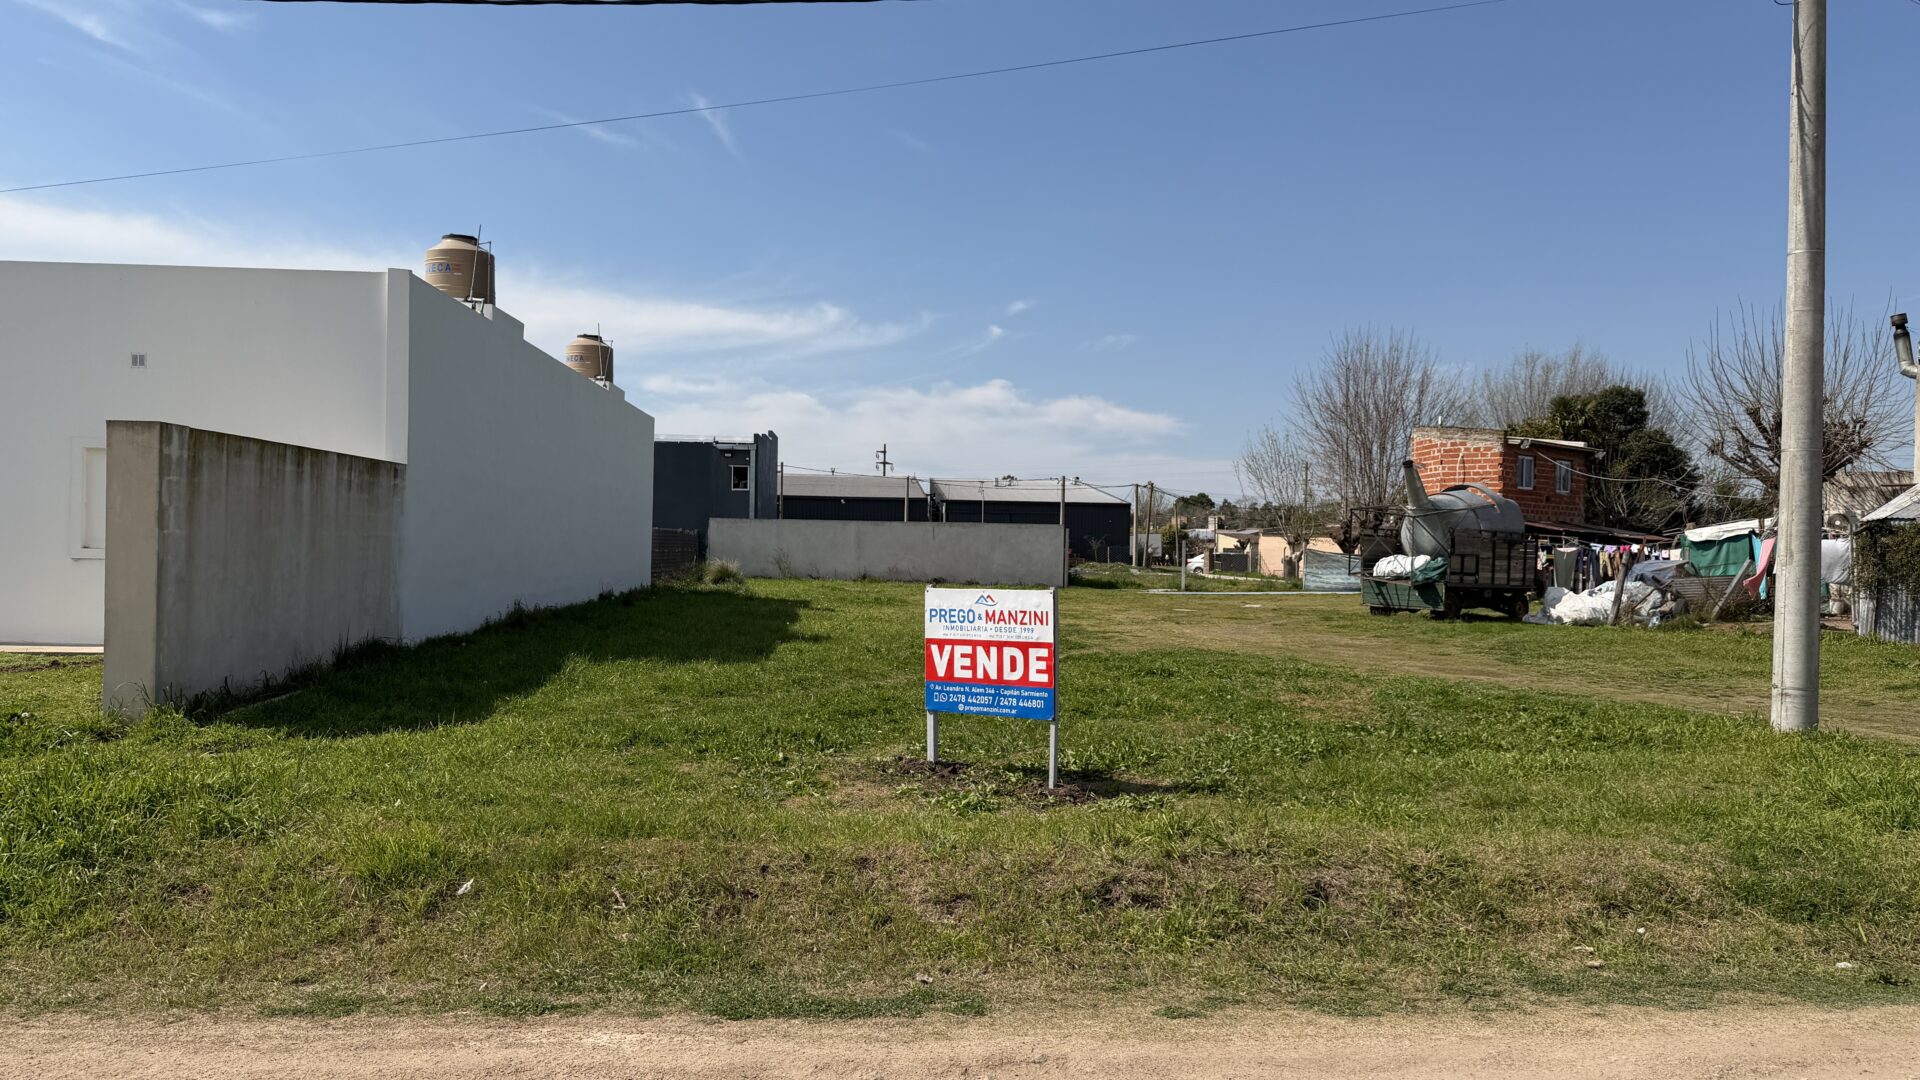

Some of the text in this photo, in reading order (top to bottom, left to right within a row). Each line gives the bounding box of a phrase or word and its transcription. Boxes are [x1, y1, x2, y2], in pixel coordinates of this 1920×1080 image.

[929, 608, 1049, 626] PREGO & MANZINI
[943, 625, 988, 633] INMOBILIARIA
[930, 644, 1049, 683] VENDE
[1000, 688, 1020, 696] Capitán
[1021, 689, 1048, 698] Sarmiento
[949, 693, 1044, 708] 2478 442057 / 2478 446801
[964, 705, 1017, 714] pregomanzini.com.ar
